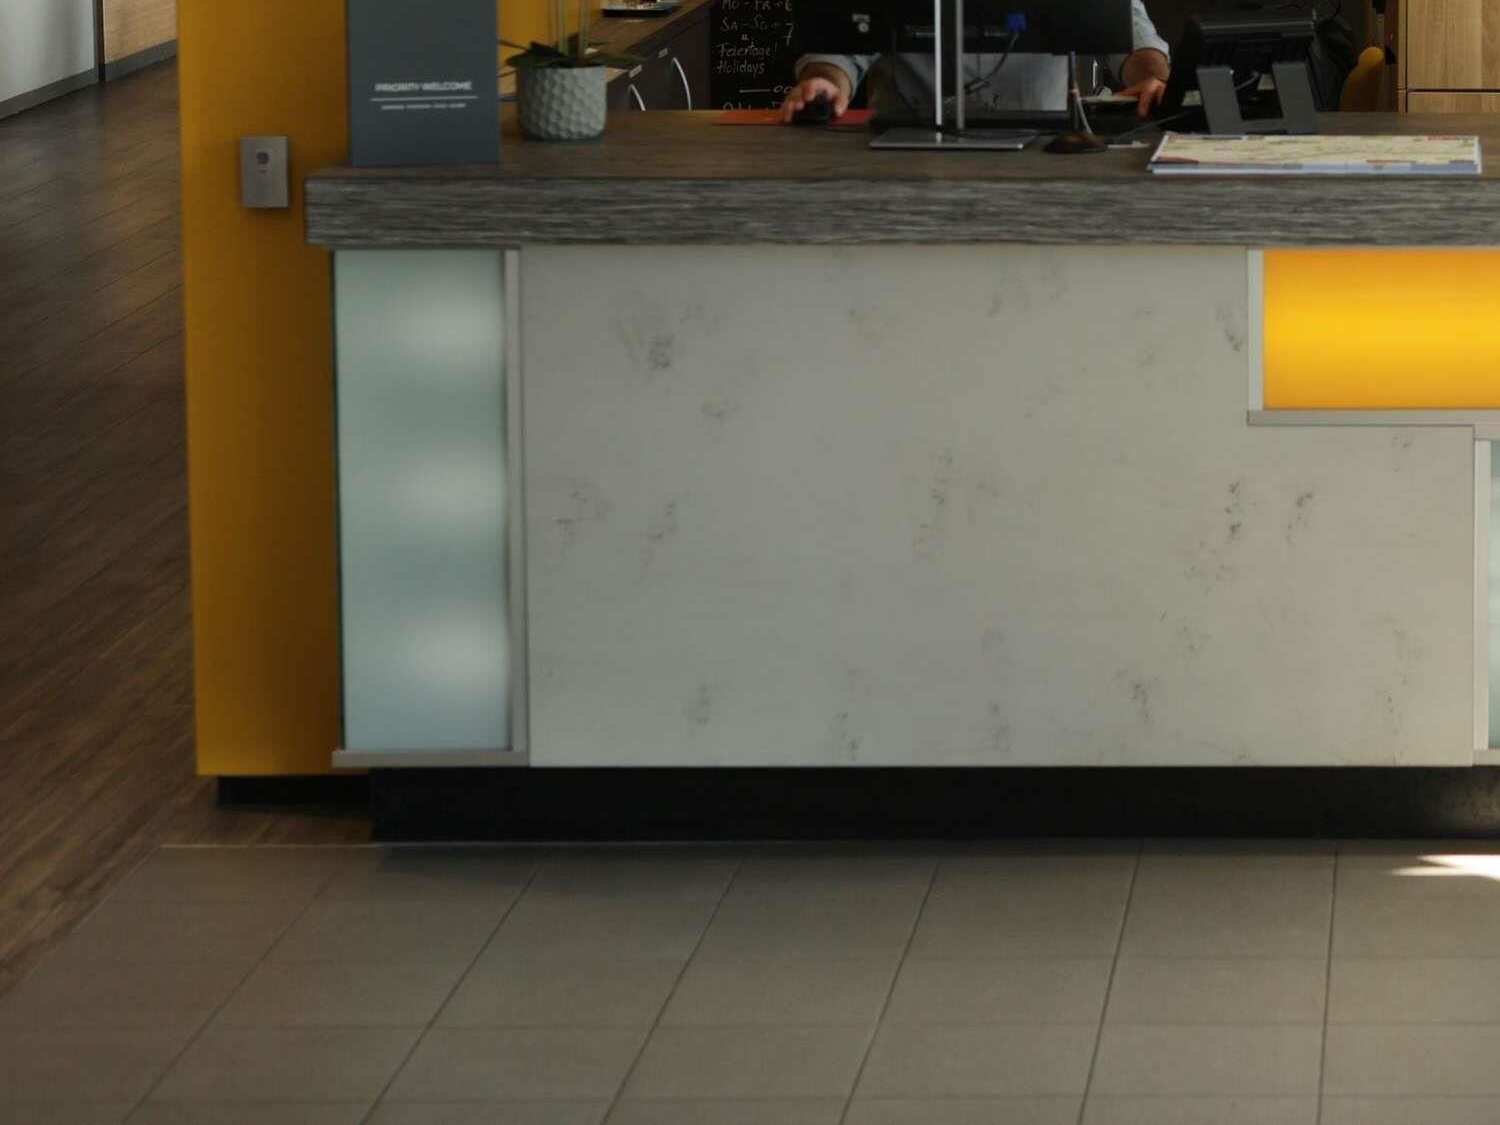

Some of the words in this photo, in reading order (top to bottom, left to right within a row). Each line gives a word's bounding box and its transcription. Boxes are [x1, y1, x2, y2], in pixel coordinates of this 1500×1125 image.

[716, 59, 765, 81] Holidays
[375, 82, 420, 92] PRIORITY
[422, 80, 472, 91] WELCOME
